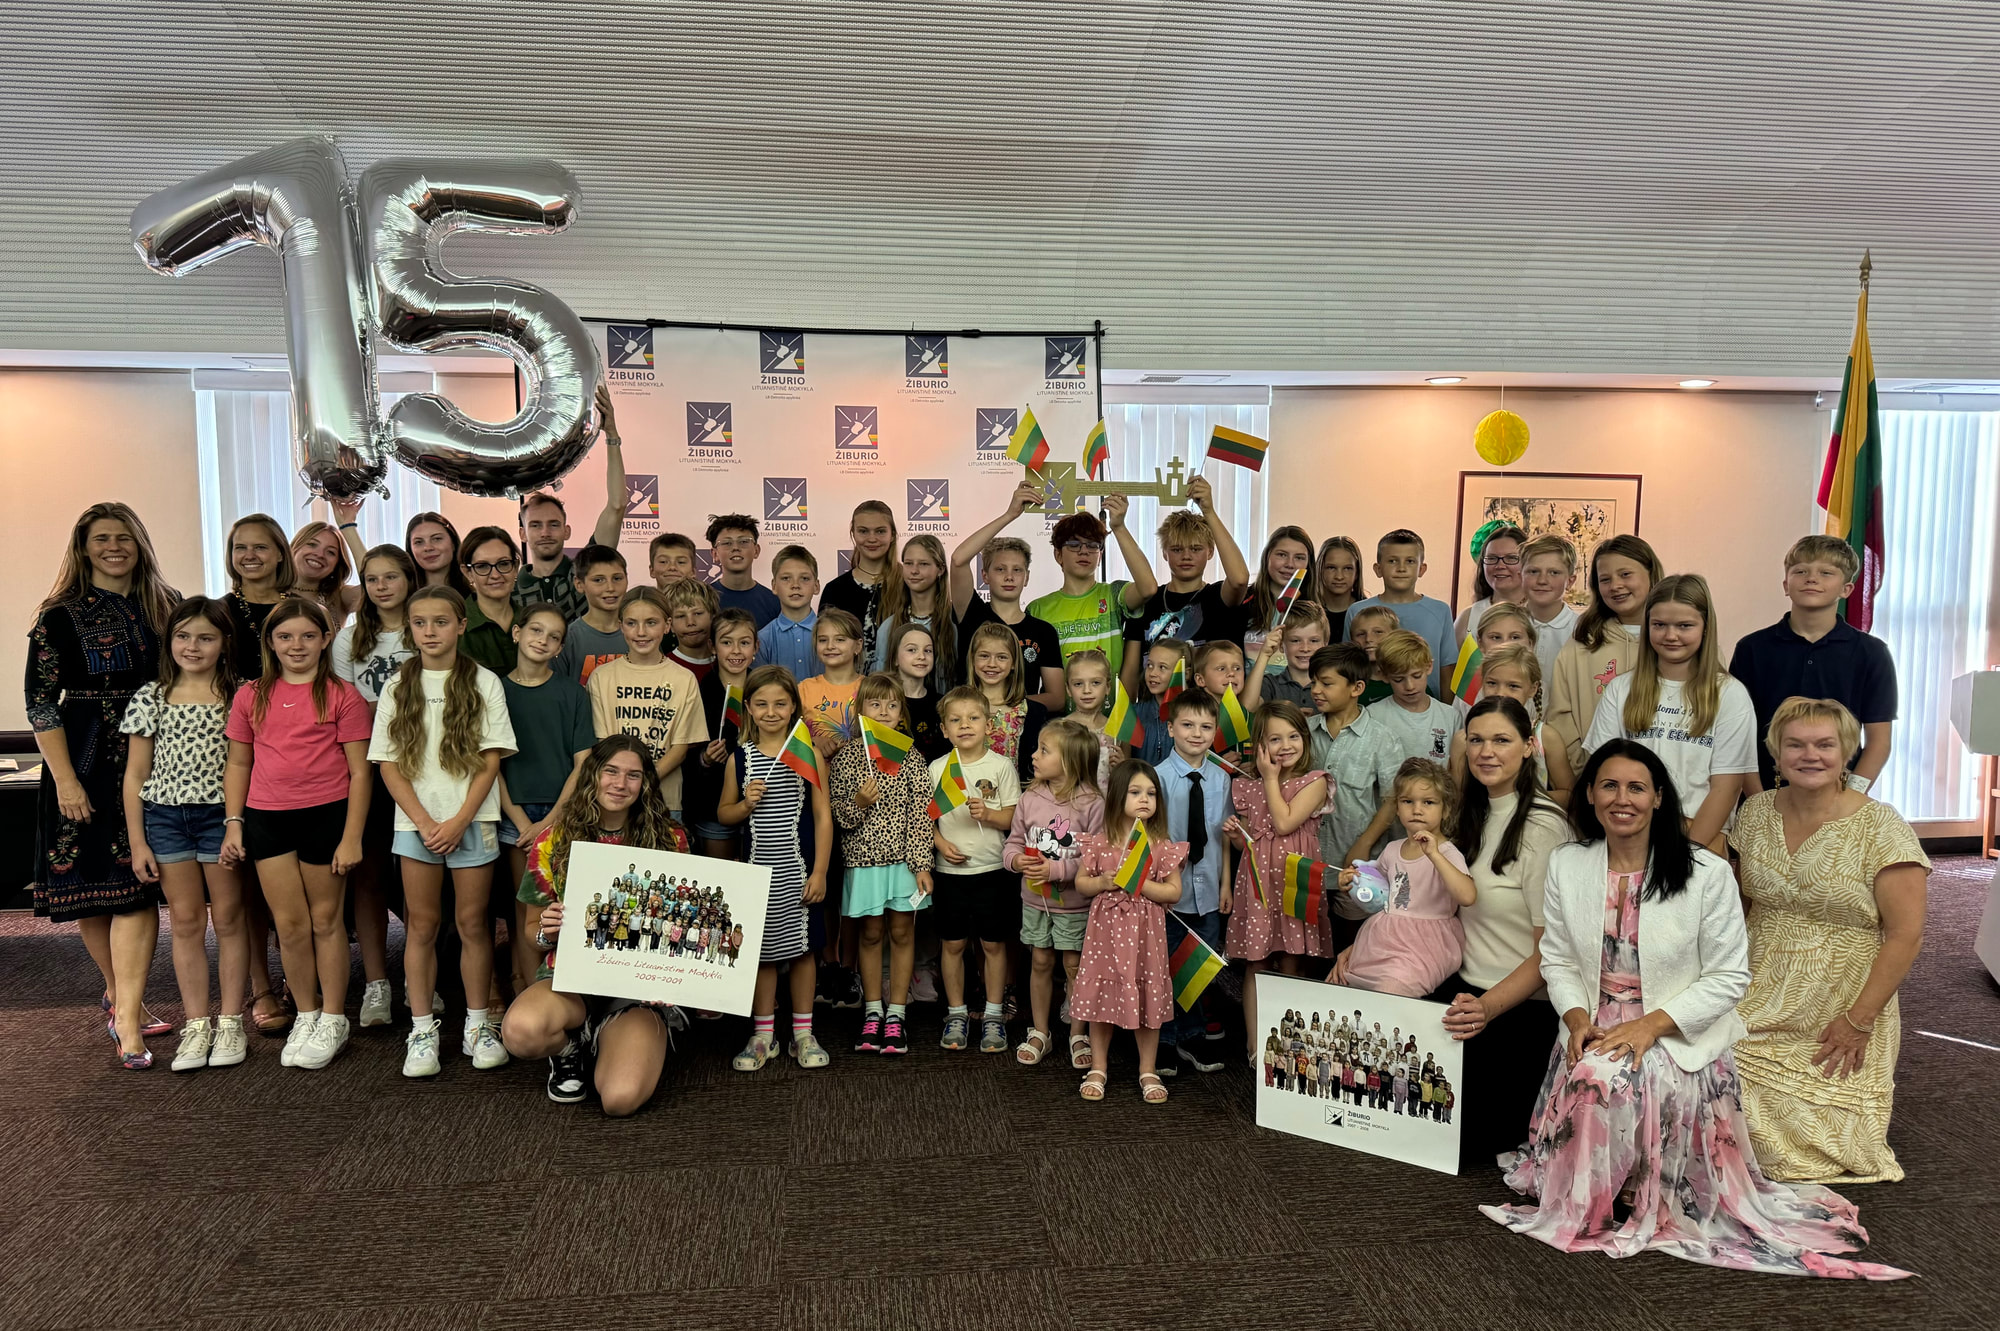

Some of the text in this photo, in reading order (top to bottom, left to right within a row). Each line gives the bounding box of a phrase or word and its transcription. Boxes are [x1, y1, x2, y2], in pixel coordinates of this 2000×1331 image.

[608, 370, 655, 381] ŽIBURIO
[760, 375, 805, 385] ŽIBURIO
[906, 379, 949, 389] ŽIBURIO
[1045, 381, 1086, 390] ŽIBURIO
[688, 447, 733, 458] ŽIBURIO
[835, 450, 879, 460] ŽIBURIO
[976, 451, 1011, 461] ŽIBUR
[622, 521, 660, 530] IBURIO
[764, 522, 808, 531] ŽIBURIO
[907, 522, 950, 532] ŽIBURIO
[1057, 622, 1101, 635] LIETUV
[616, 686, 672, 701] SPREAD
[596, 953, 631, 967] Žiburio
[688, 968, 724, 980] Mokykla
[634, 972, 683, 985] 2008-2009
